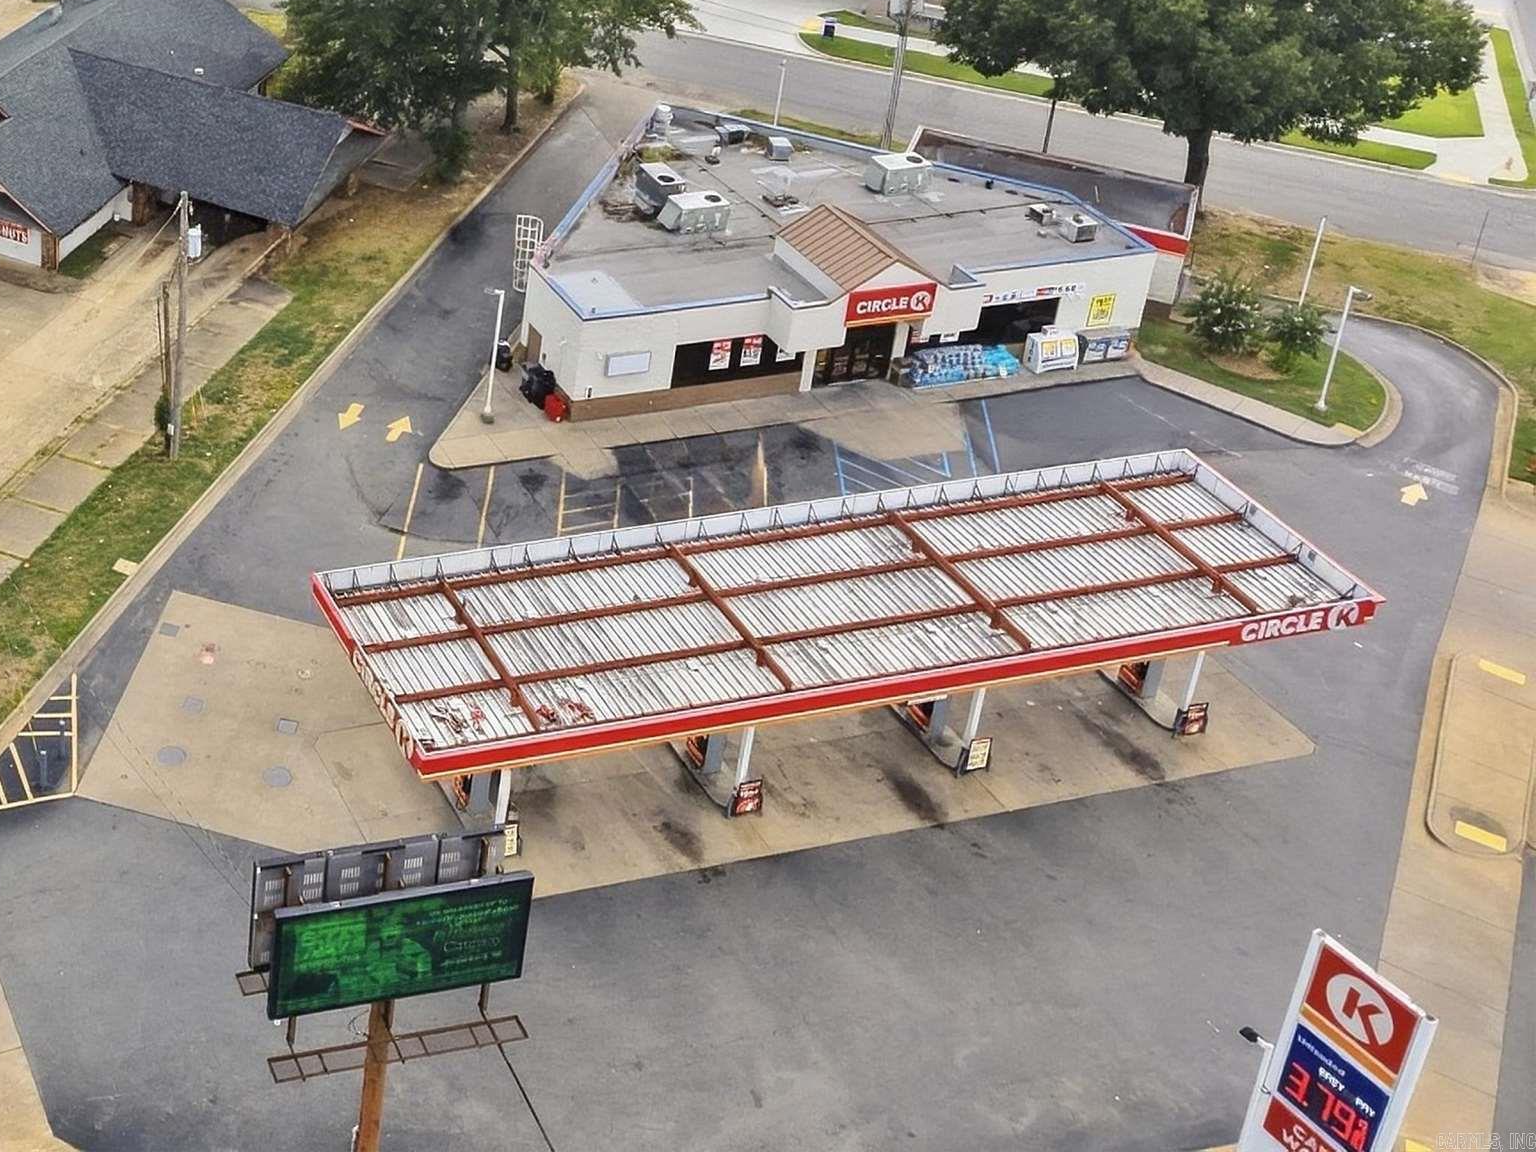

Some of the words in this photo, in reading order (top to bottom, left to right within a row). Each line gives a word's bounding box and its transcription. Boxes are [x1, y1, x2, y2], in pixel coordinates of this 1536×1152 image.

[856, 296, 909, 314] CIRCLE
[912, 292, 930, 310] K
[1241, 611, 1325, 642] CIRCLE
[1332, 603, 1358, 630] K
[1333, 979, 1390, 1047] K
[1318, 1066, 1345, 1091] EASY
[1355, 1096, 1375, 1117] PAY
